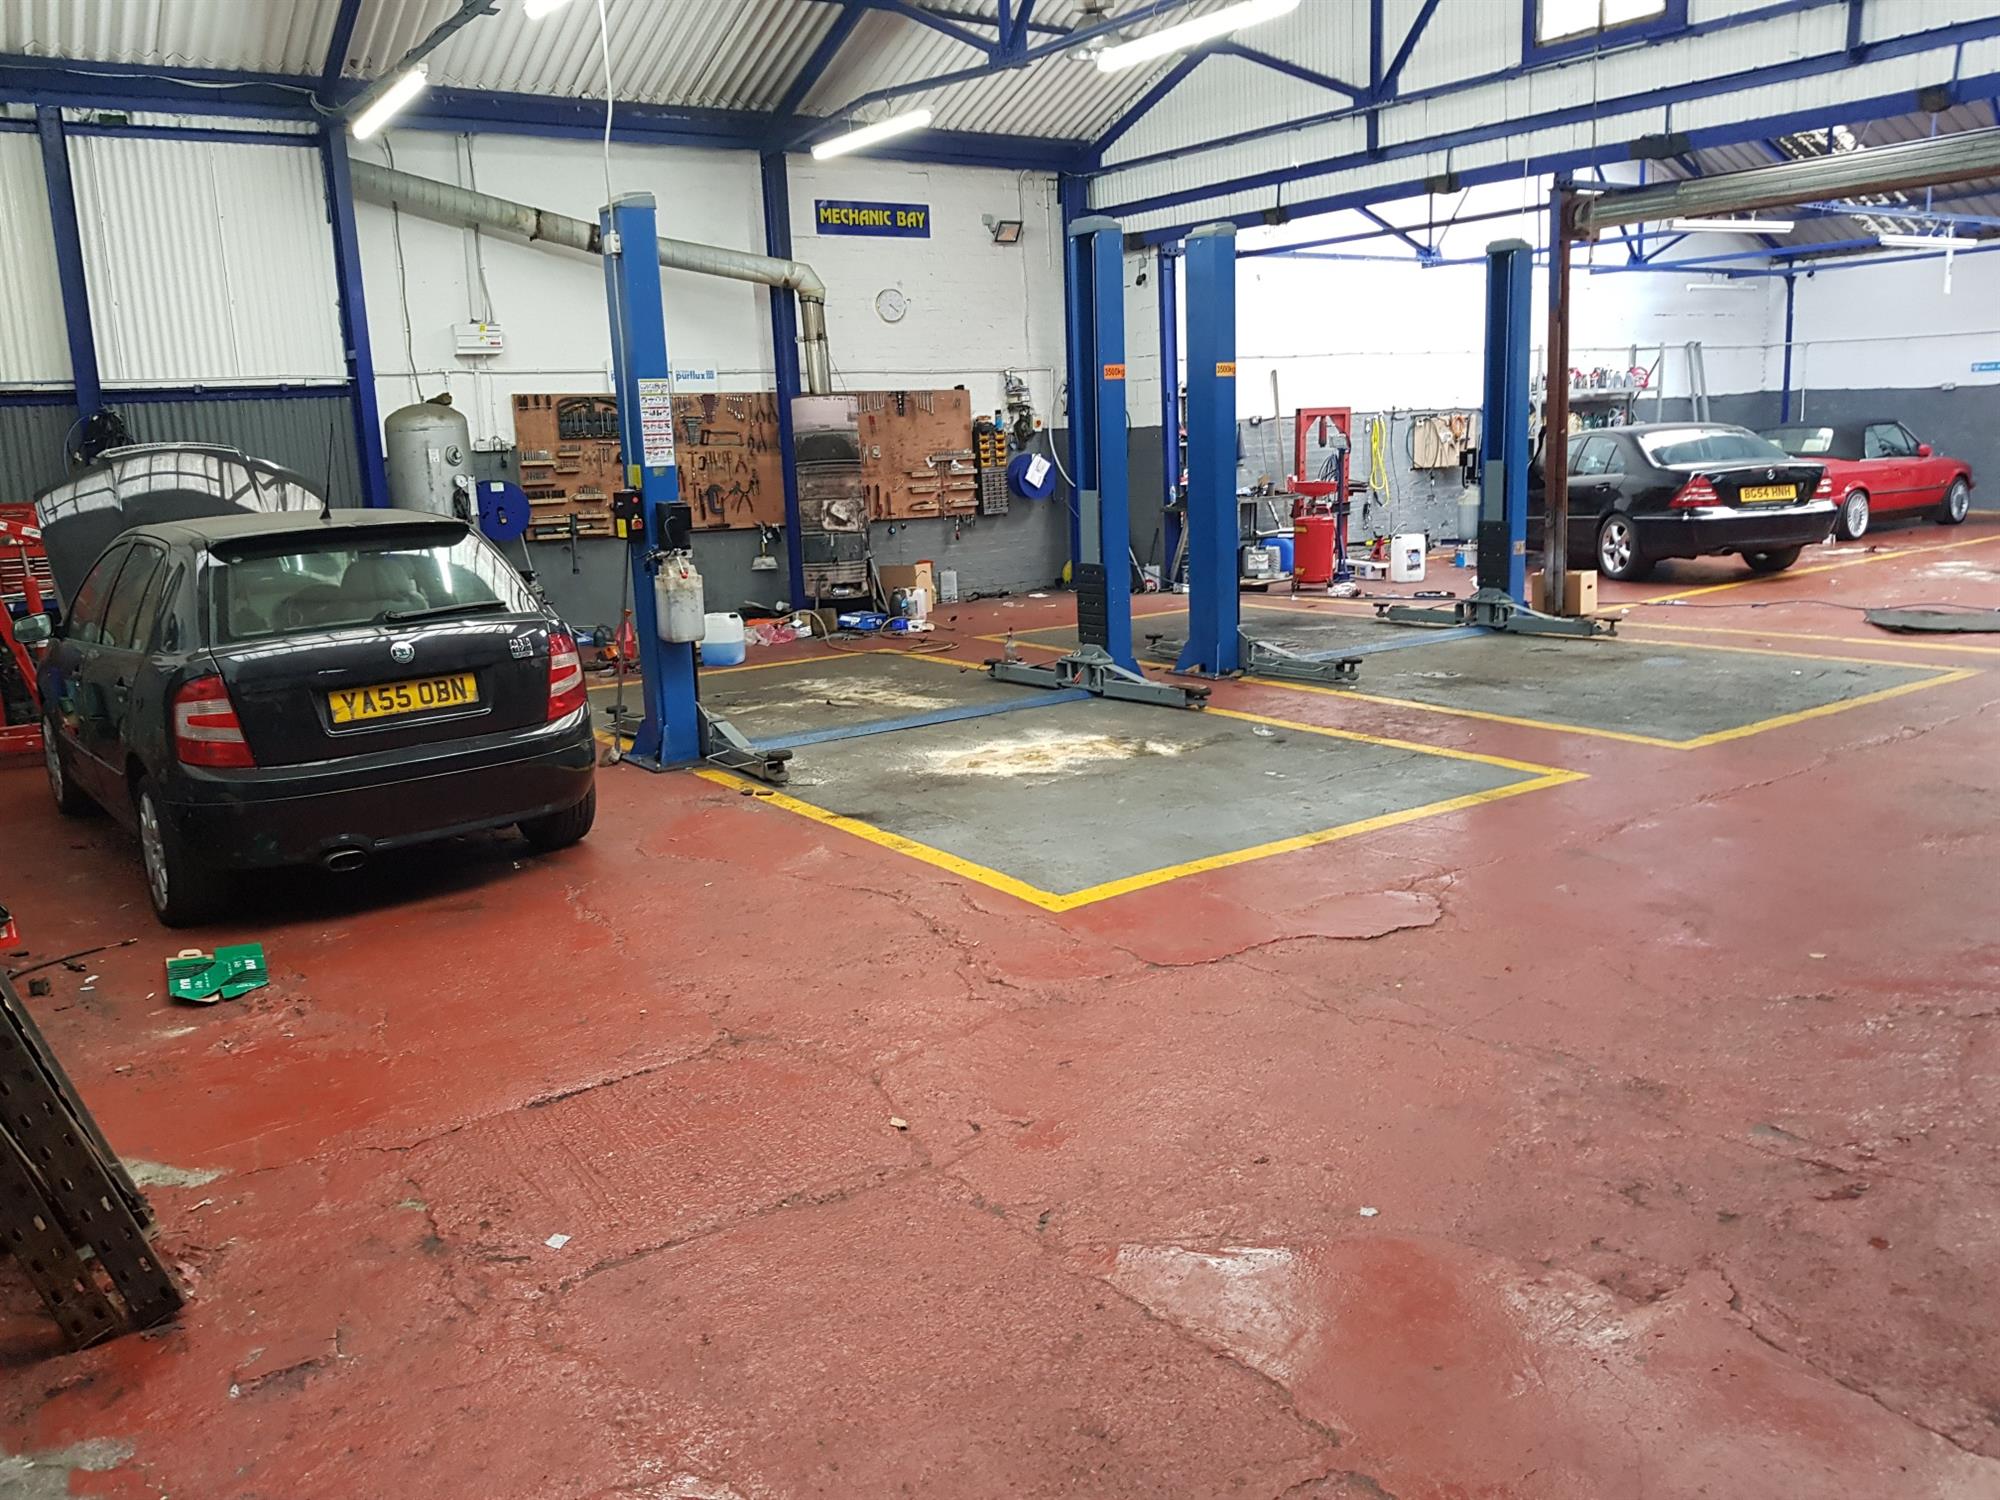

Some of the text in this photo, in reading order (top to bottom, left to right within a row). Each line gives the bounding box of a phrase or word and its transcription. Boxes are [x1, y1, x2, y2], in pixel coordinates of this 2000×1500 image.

[820, 207, 925, 229] MECHANIC BAY
[1744, 487, 1769, 499] BG54
[341, 677, 468, 719] YA55 OBN
